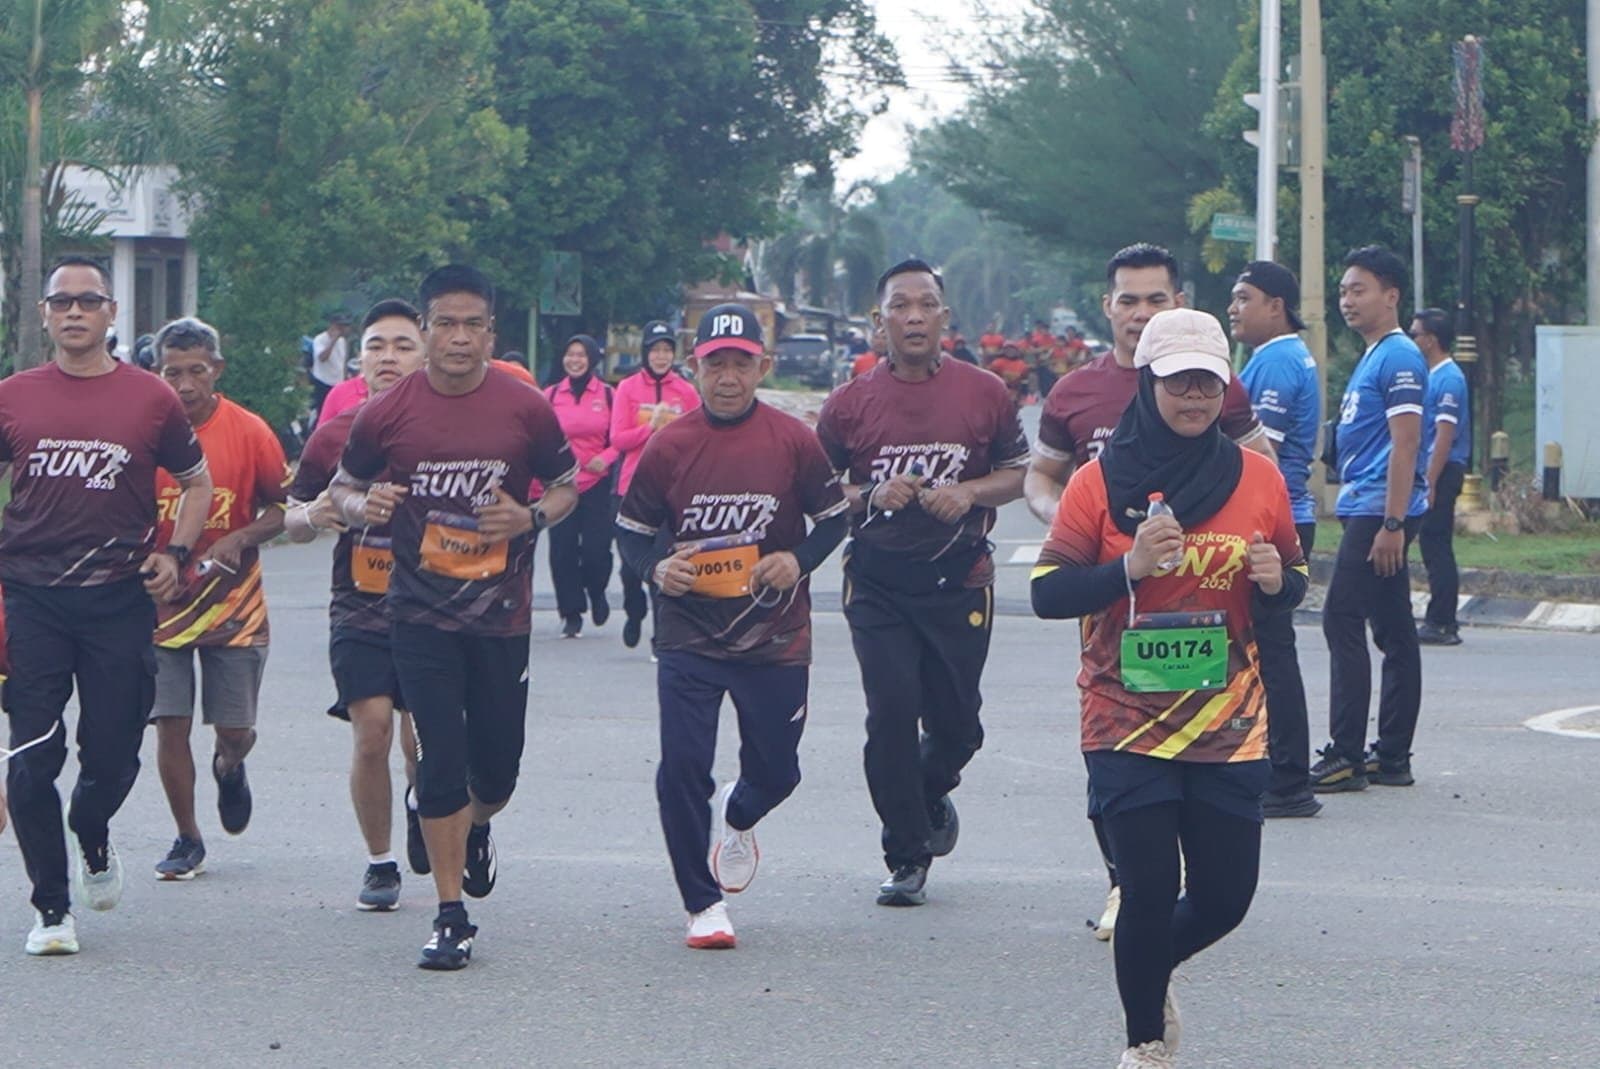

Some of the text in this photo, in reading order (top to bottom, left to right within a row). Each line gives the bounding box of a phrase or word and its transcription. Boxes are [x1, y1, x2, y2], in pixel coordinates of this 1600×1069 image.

[37, 437, 122, 452] Bhayangkara
[879, 437, 962, 456] Bhayangkara
[28, 450, 98, 477] RUN
[416, 458, 503, 473] Bhayangkara
[871, 455, 939, 481] RUN
[410, 471, 479, 498] RUN
[691, 491, 772, 506] Bhayangkara
[680, 505, 750, 532] RUN
[694, 559, 743, 576] V0016
[1137, 640, 1213, 660] U0174
